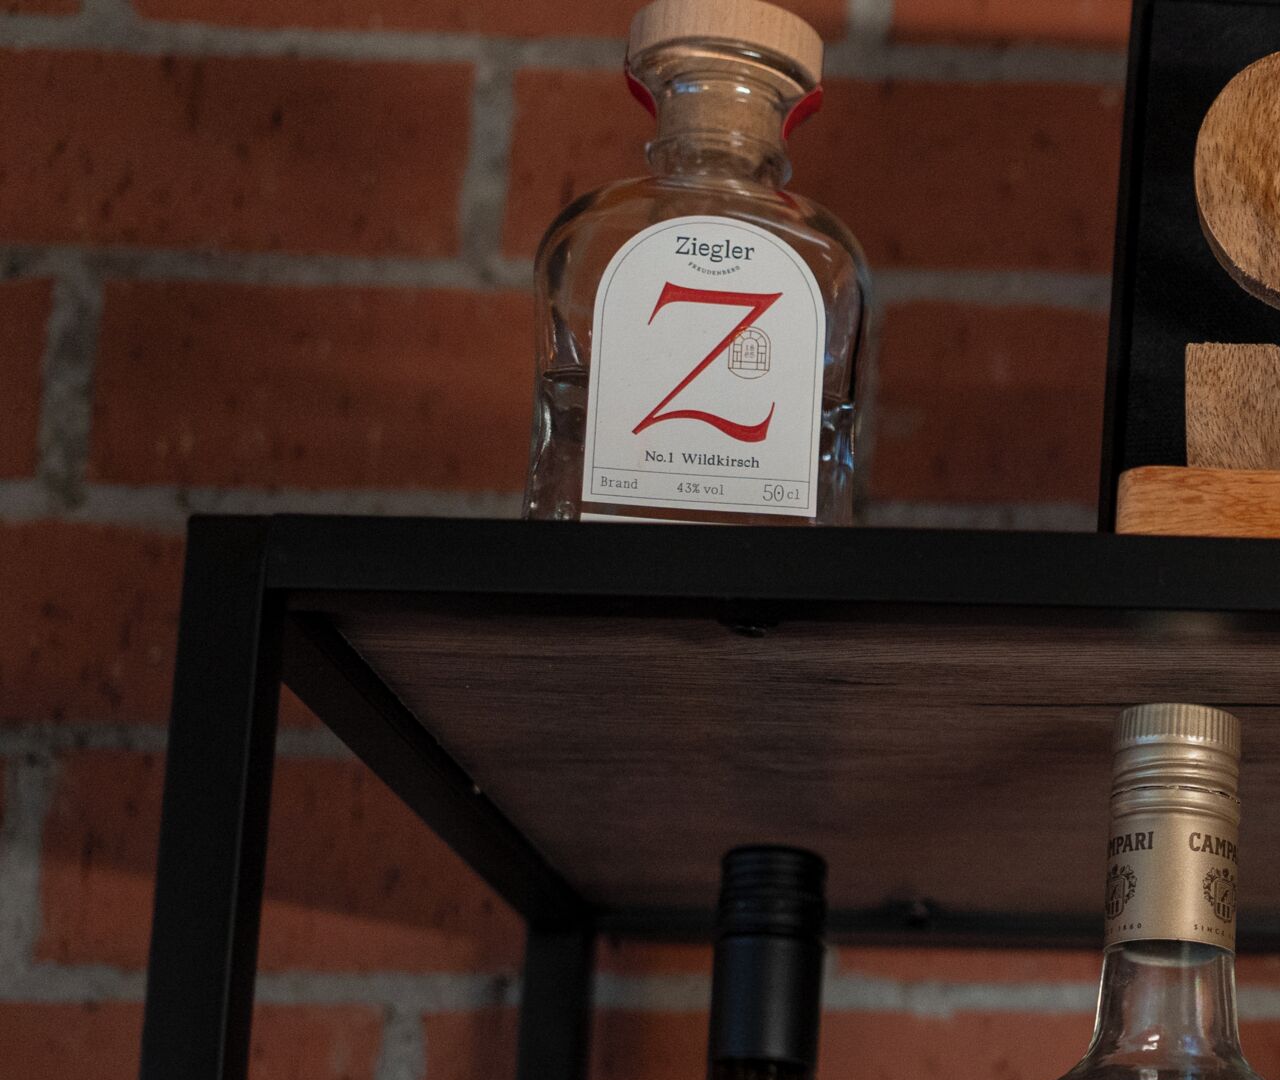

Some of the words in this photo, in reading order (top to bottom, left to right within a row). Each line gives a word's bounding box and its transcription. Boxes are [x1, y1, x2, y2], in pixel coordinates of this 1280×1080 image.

[675, 236, 755, 262] Ziegler
[632, 281, 783, 442] Z
[644, 450, 674, 463] No.1
[681, 452, 760, 469] Wildkirsch
[600, 475, 638, 490] Brand
[676, 481, 701, 494] 43%
[703, 484, 725, 495] vol
[762, 484, 784, 502] 50
